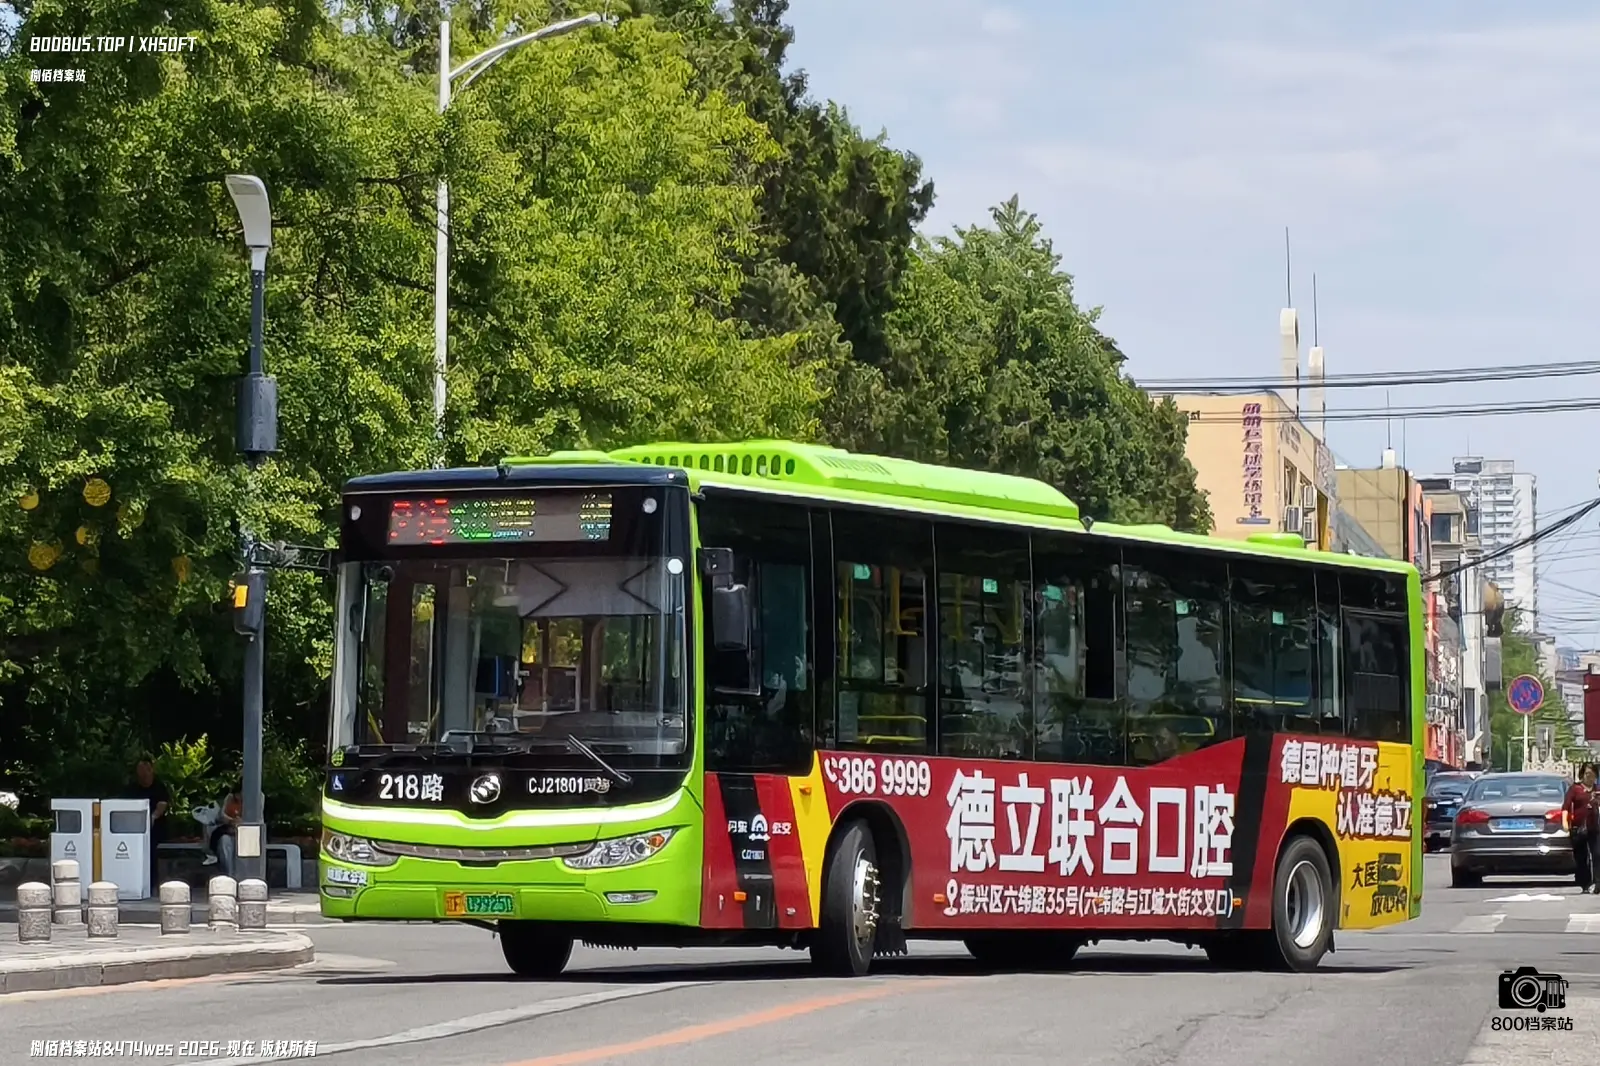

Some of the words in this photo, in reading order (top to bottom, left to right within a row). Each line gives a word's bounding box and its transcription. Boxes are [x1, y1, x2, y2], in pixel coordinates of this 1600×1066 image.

[528, 776, 583, 794] CJ21801
[838, 757, 876, 795] 386
[881, 760, 932, 797] 9999
[1281, 739, 1378, 791] 德国种植牙
[379, 774, 444, 801] 218路
[946, 768, 1236, 878] 德立联合口腔
[1338, 791, 1412, 838] 认准德立
